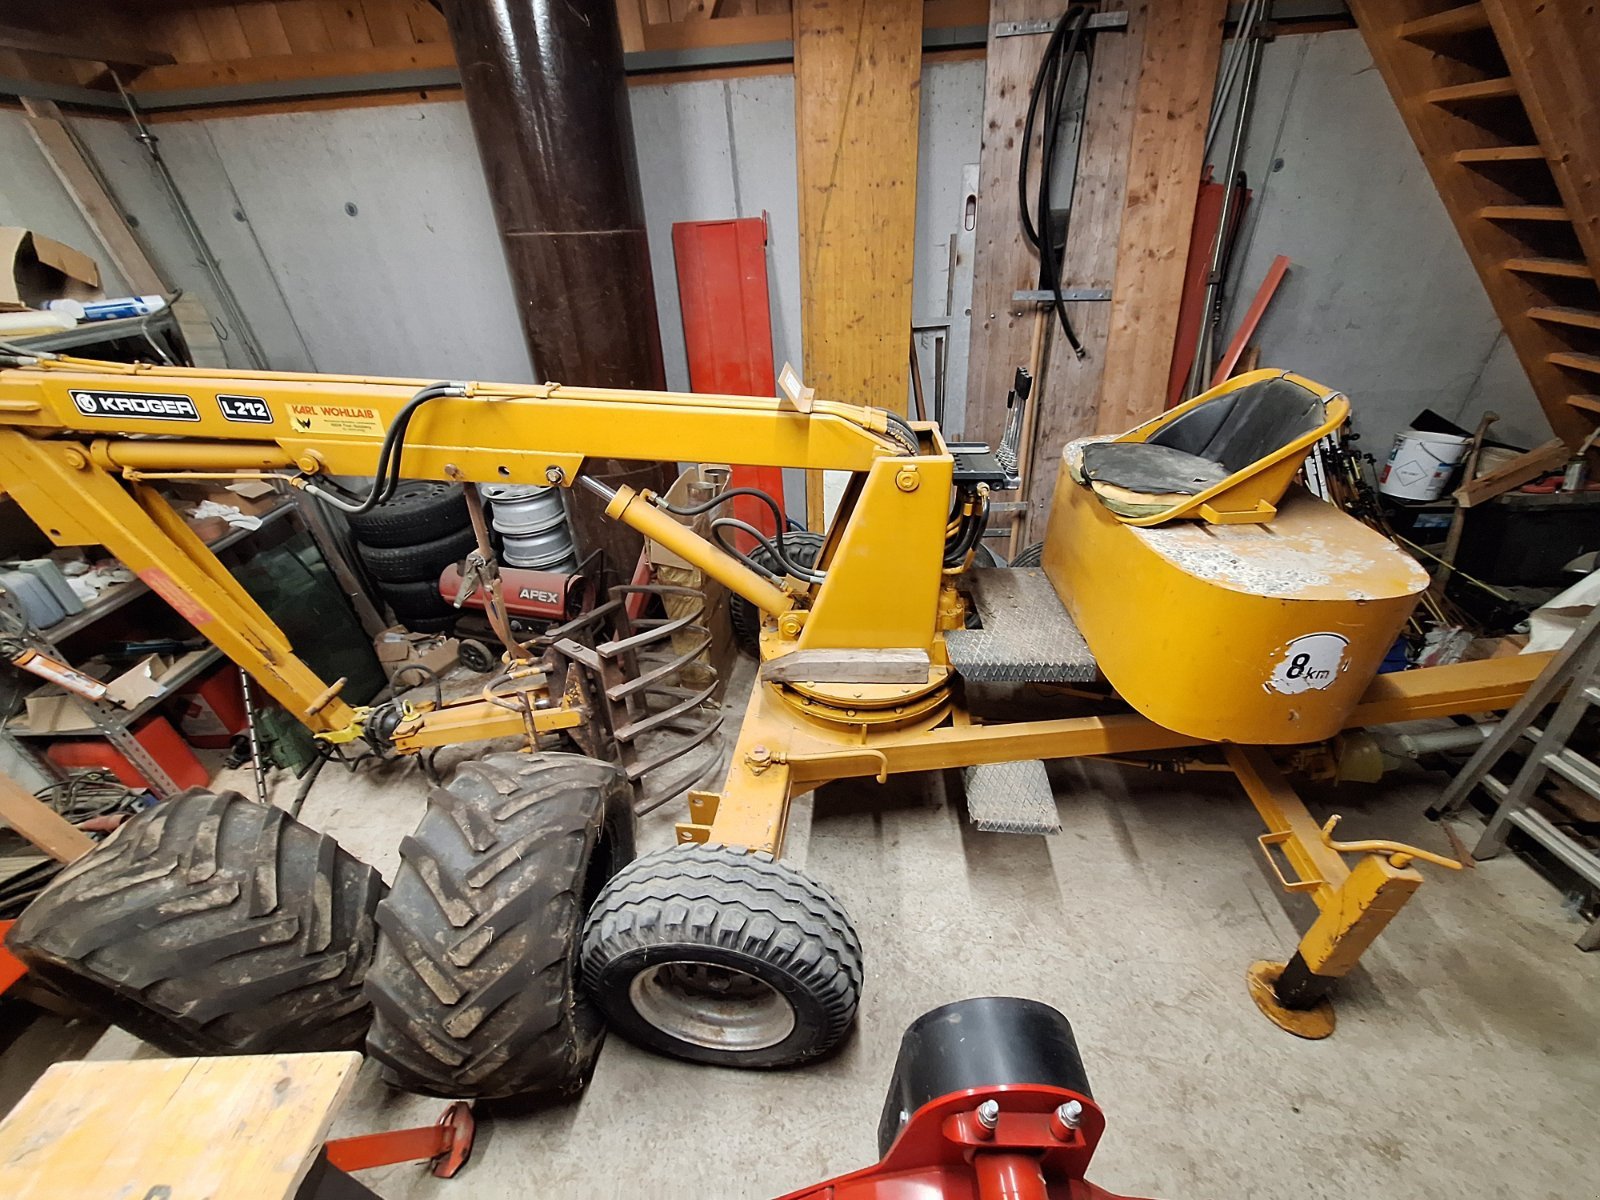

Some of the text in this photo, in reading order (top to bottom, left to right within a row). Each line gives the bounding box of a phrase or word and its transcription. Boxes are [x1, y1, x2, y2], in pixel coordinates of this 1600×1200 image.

[221, 400, 268, 417] L212
[291, 404, 374, 419] KARL WOHLLAIB
[519, 588, 558, 604] APEX
[1286, 653, 1330, 680] 8 km
